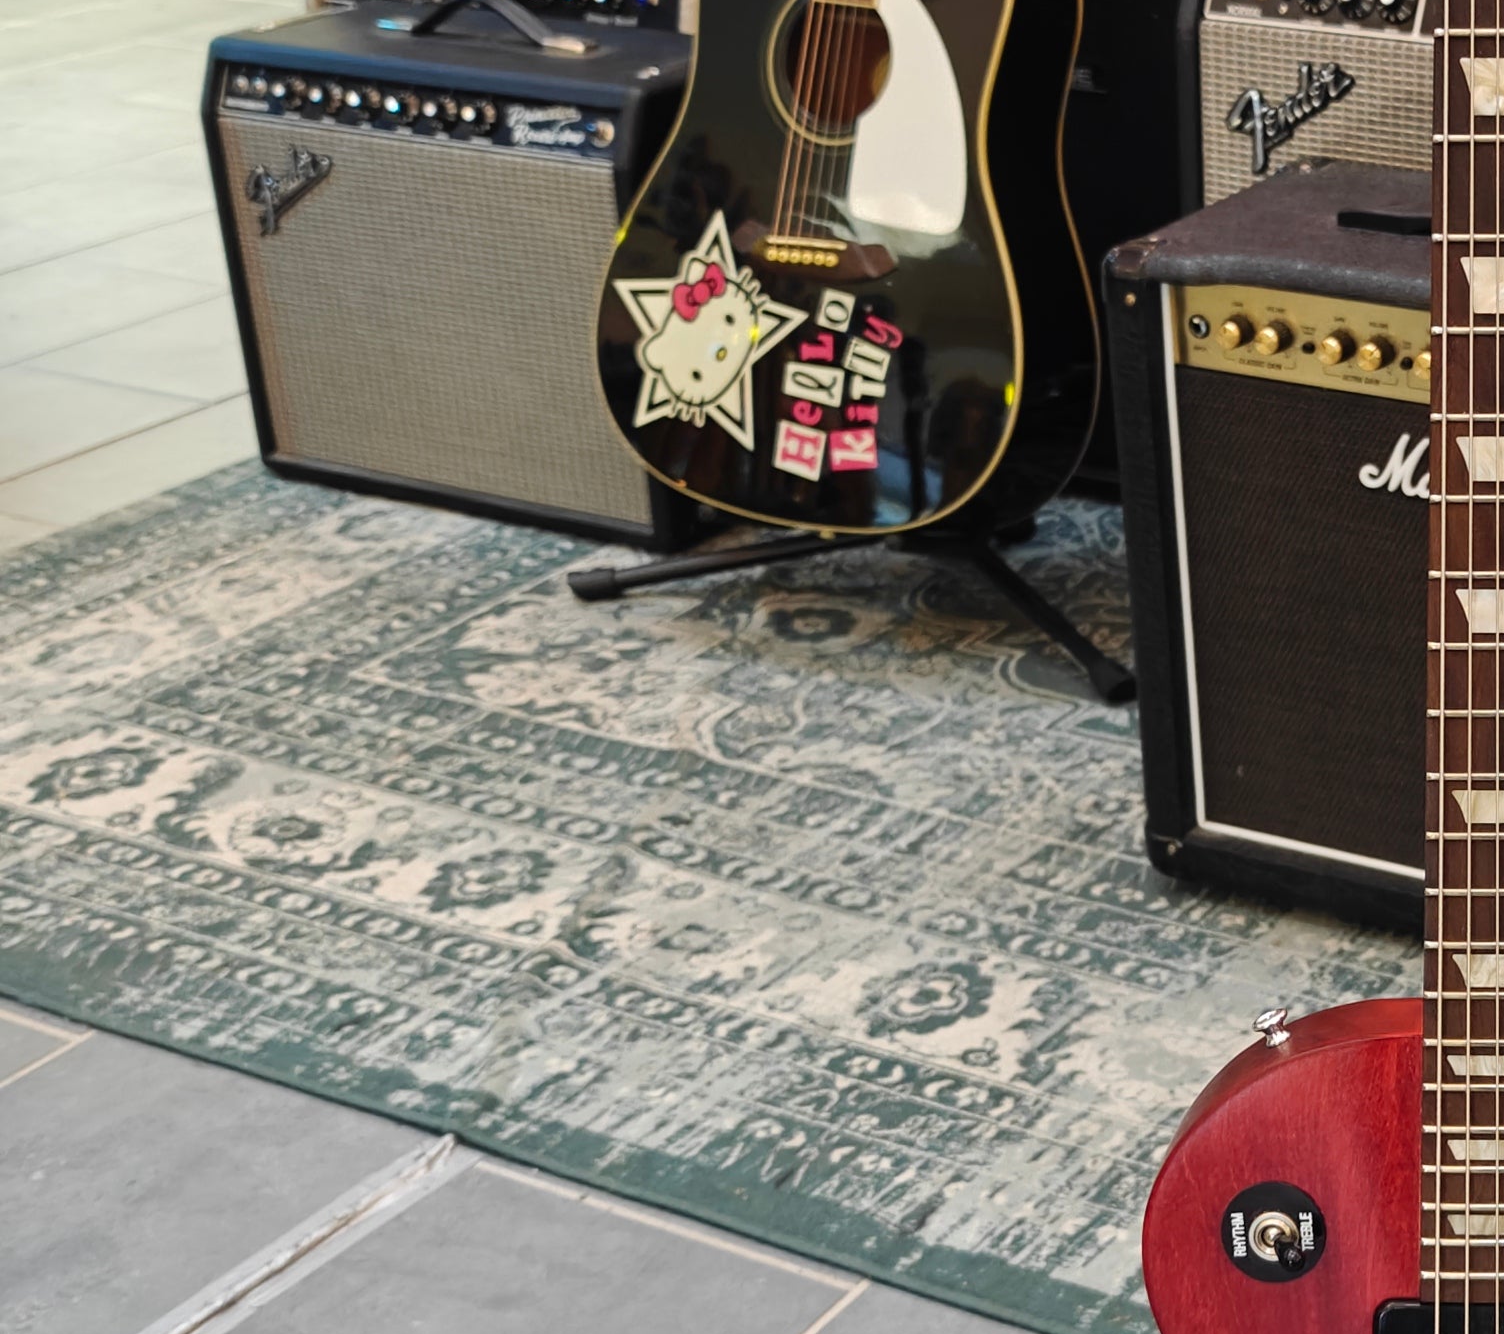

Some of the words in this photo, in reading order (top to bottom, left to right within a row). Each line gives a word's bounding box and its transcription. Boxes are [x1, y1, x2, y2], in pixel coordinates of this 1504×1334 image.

[1225, 62, 1357, 174] Fender
[1230, 1211, 1248, 1259] RHYTHM
[1298, 1211, 1316, 1252] TREBLE
